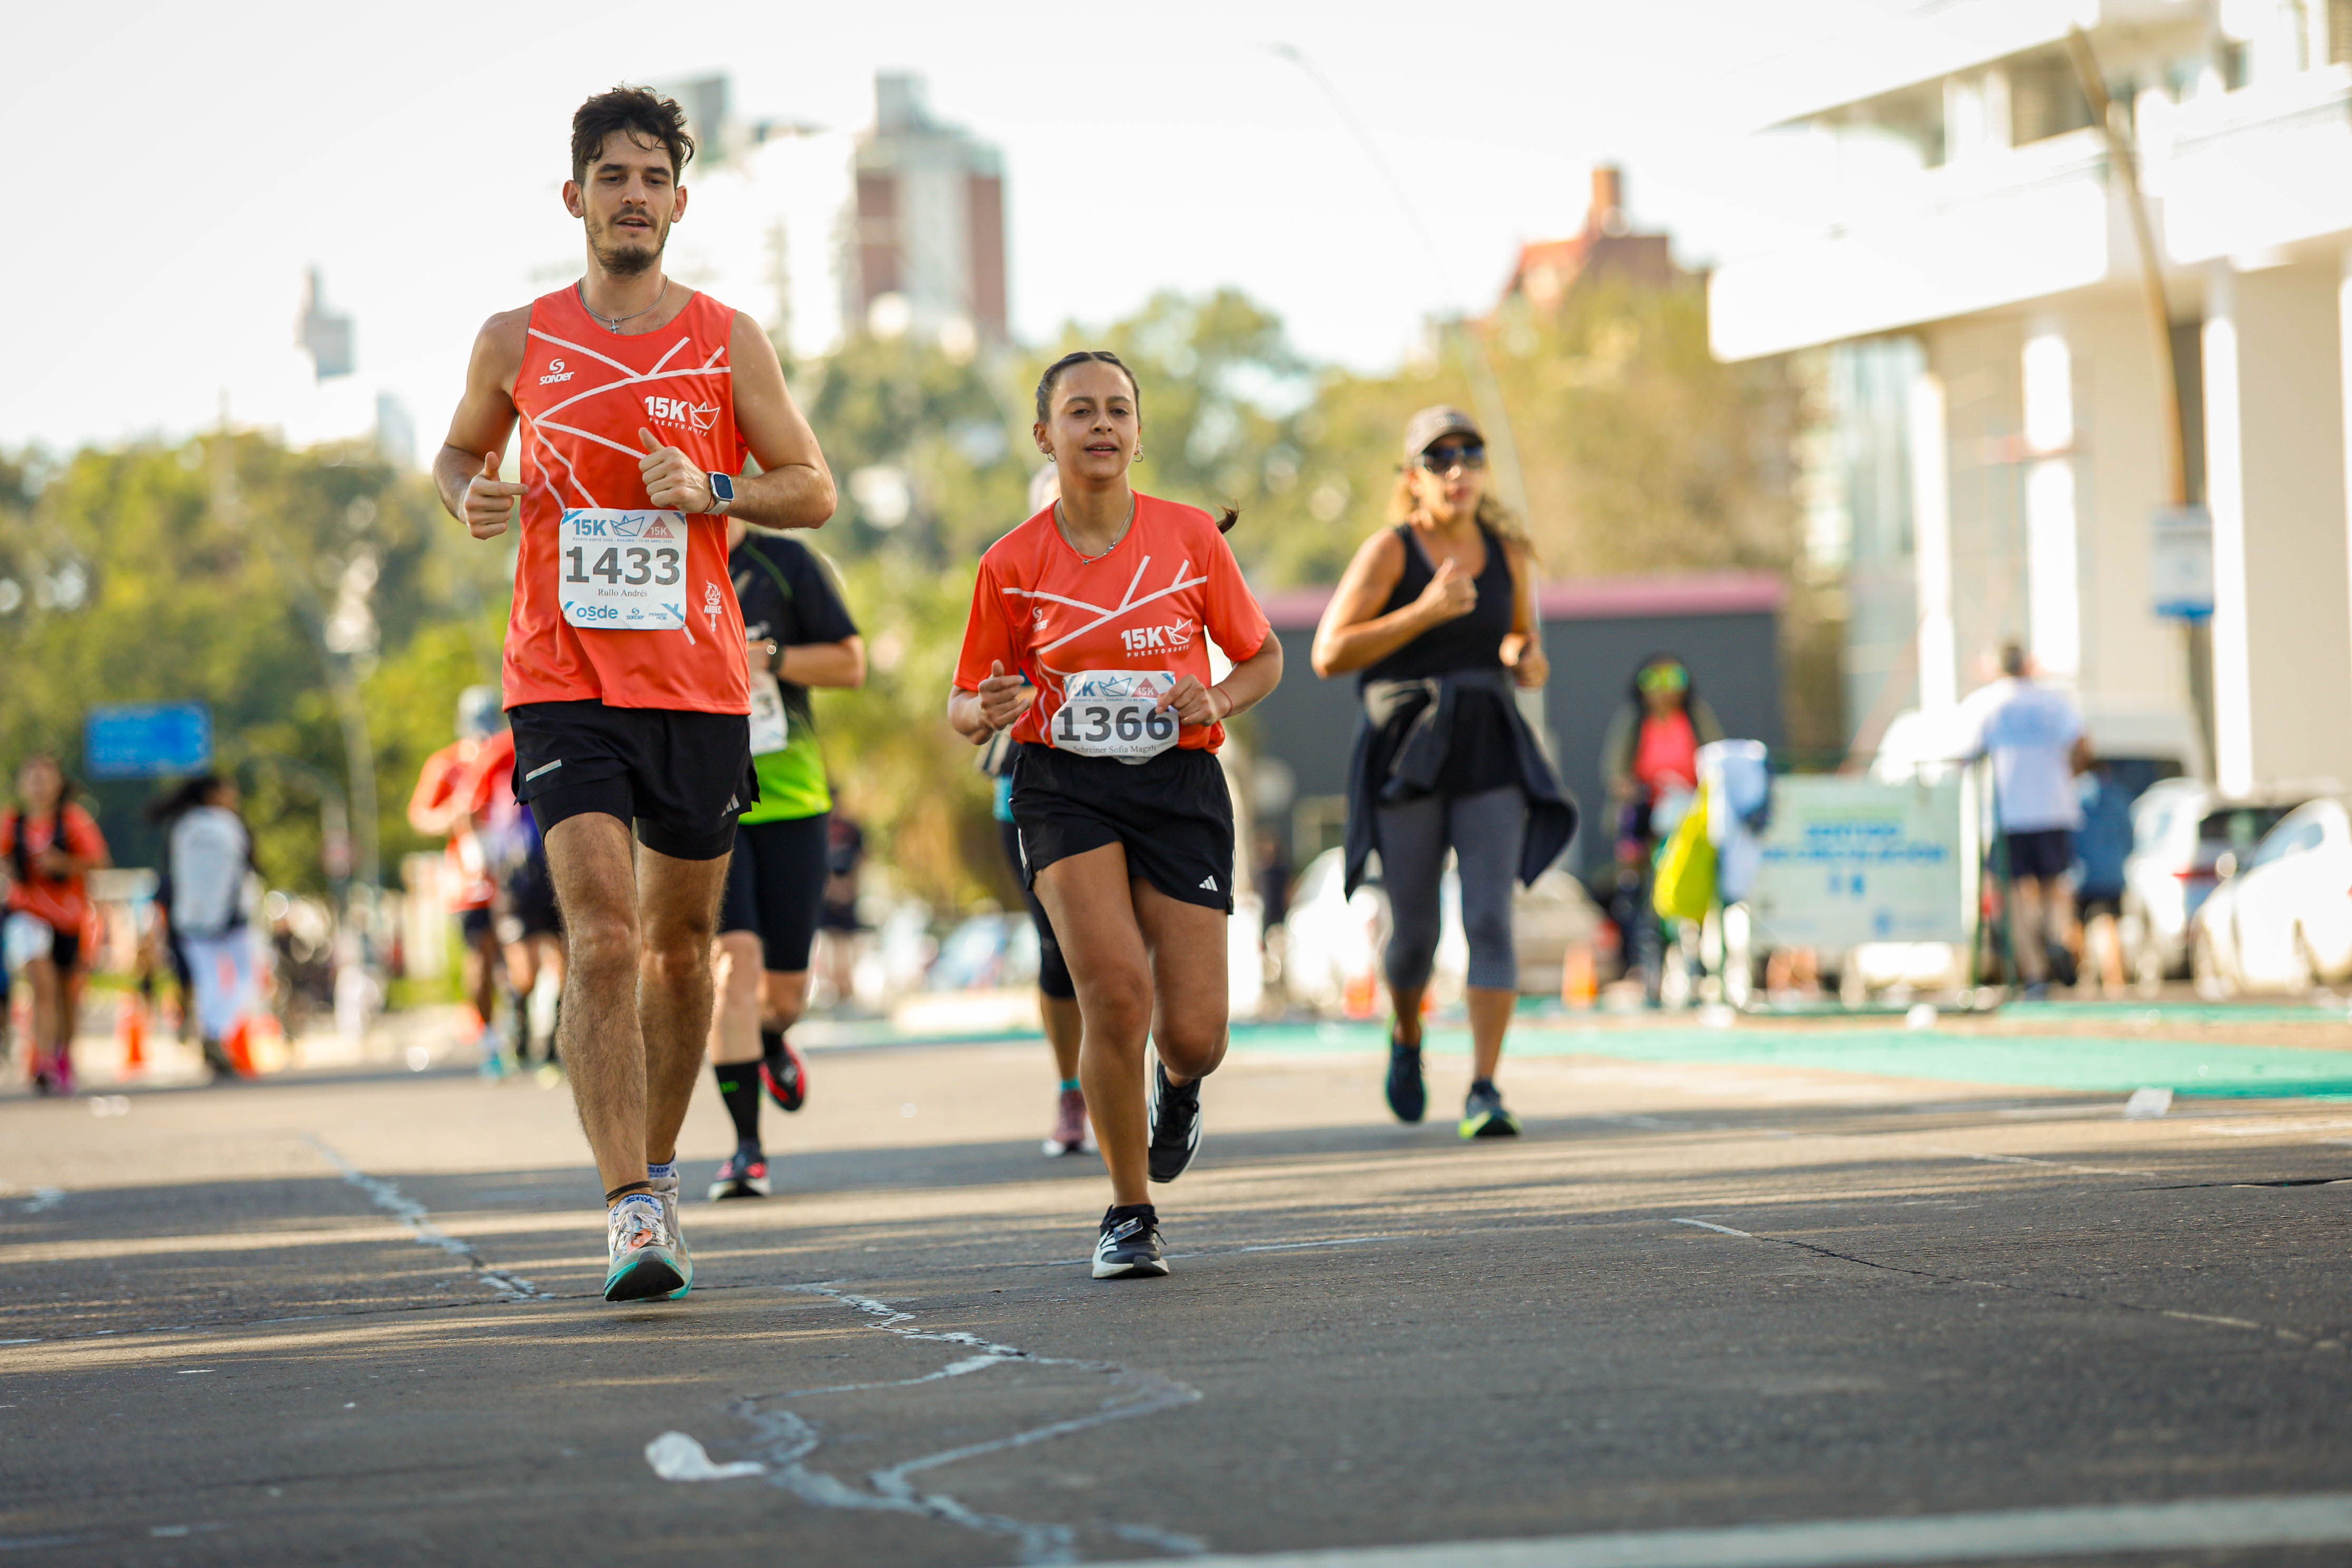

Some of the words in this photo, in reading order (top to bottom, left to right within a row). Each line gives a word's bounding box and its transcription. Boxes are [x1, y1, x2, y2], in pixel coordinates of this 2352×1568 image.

[645, 396, 689, 422] 15K
[573, 519, 607, 536] 15K
[651, 527, 667, 536] 15K
[566, 546, 680, 585] 1433
[598, 589, 619, 597] Rullo
[621, 588, 648, 597] Andrés
[576, 605, 618, 620] osde
[703, 605, 722, 614] ARDEC
[1121, 626, 1165, 650] 15K
[1138, 687, 1155, 696] 15K
[1058, 706, 1173, 742] 1366
[1073, 745, 1107, 753] Schreiner
